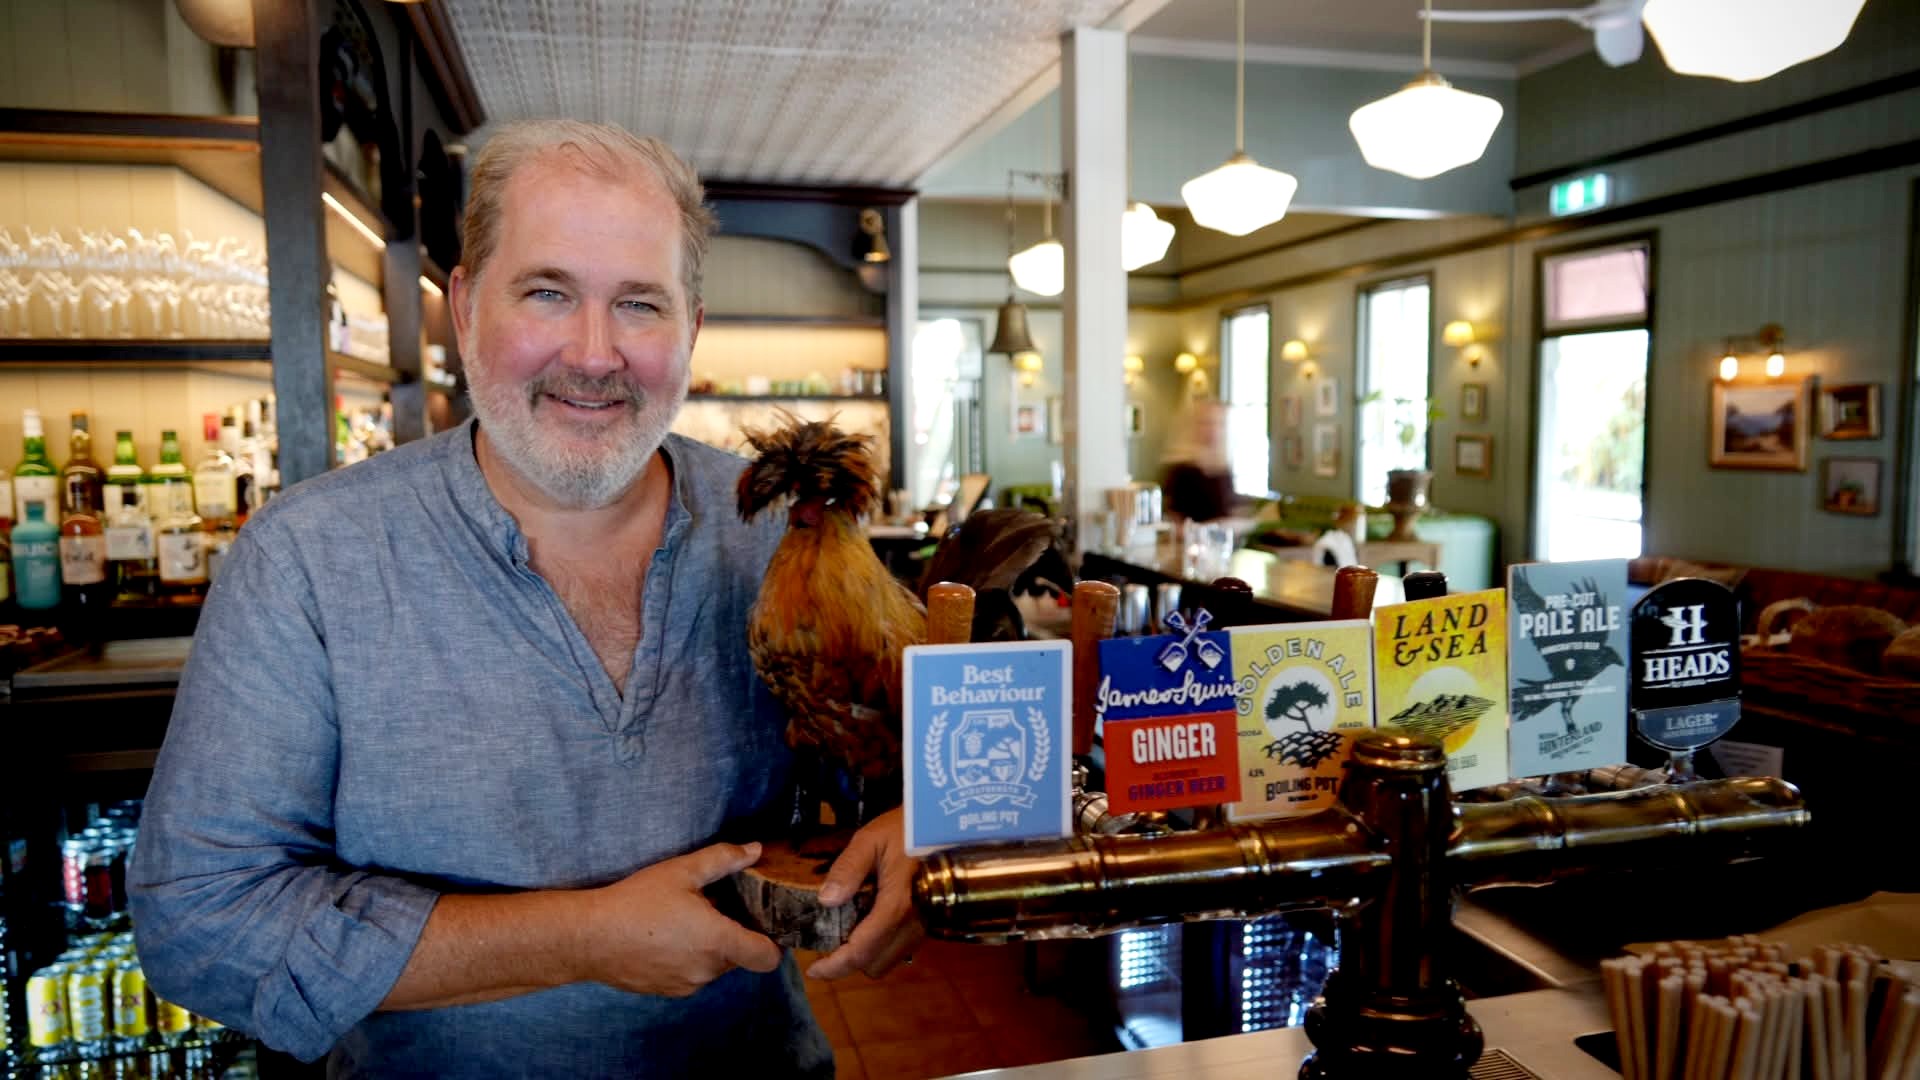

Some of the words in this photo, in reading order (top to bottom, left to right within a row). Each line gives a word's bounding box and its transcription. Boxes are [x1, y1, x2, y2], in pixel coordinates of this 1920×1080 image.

[1393, 603, 1489, 640] LAND
[1519, 610, 1575, 639] PALE
[1580, 606, 1621, 633] ALE
[1394, 641, 1425, 667] &
[1426, 630, 1489, 662] SEA
[1642, 649, 1730, 682] HEADS
[963, 664, 1014, 685] Best
[1096, 675, 1171, 713] James
[1172, 669, 1244, 705] Squire
[1235, 638, 1325, 716] GOLDEN
[1325, 653, 1363, 709] ALE
[930, 685, 1046, 706] Behaviour
[1132, 722, 1217, 764] GINGER
